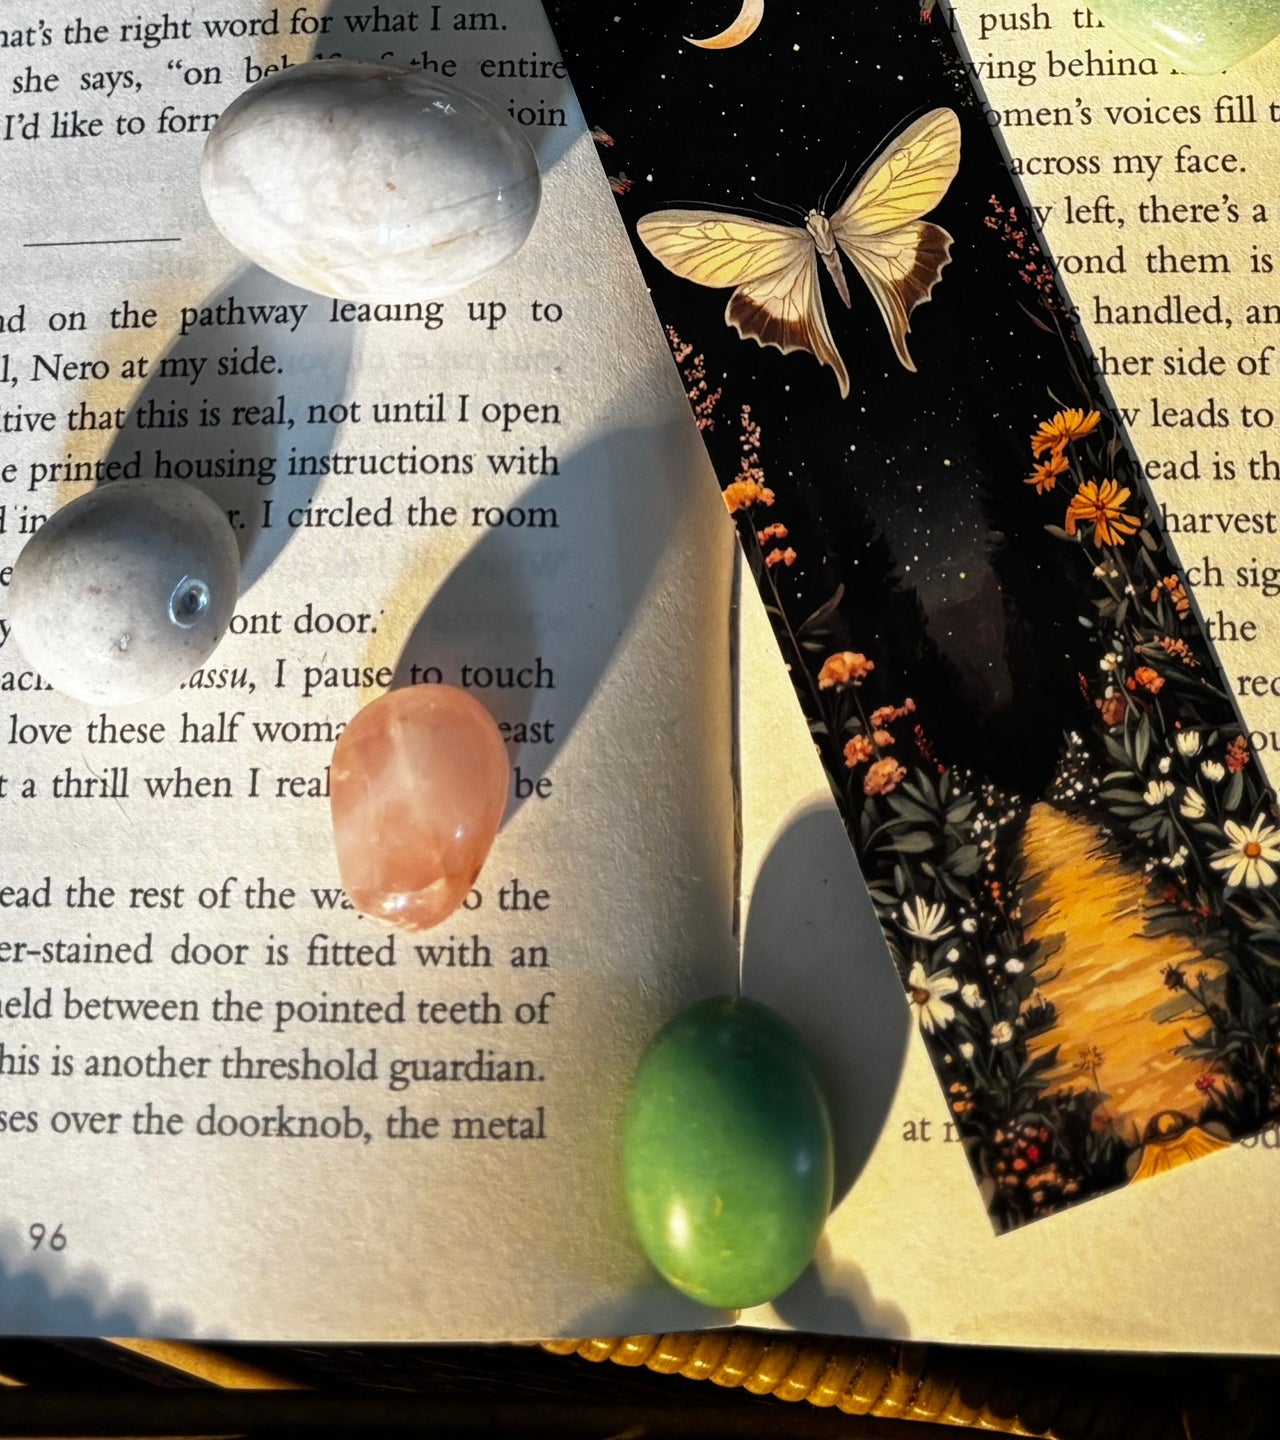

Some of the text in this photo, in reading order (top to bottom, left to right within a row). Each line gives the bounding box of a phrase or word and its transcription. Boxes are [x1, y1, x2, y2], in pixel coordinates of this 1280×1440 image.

[11, 65, 60, 95] she
[79, 69, 143, 99] says,
[166, 58, 223, 87] “on
[480, 51, 567, 79] entire
[1009, 143, 1247, 183] across my face.
[1063, 194, 1126, 230] left,
[1137, 193, 1241, 225] there’s
[1251, 203, 1269, 224] a
[30, 353, 111, 382] Nero
[119, 356, 149, 380] at
[157, 356, 209, 387] my
[217, 344, 284, 377] side.
[1211, 459, 1237, 482] is
[1160, 503, 1278, 535] harvest
[63, 986, 200, 1022] between
[211, 988, 264, 1023] the
[273, 990, 406, 1034] pointed
[416, 990, 503, 1026] teeth
[514, 990, 557, 1026] of
[50, 1054, 74, 1077] is
[84, 1044, 212, 1079] another
[221, 1046, 379, 1082] threshold
[388, 1048, 546, 1093] guardian.
[29, 1222, 67, 1252] 96
